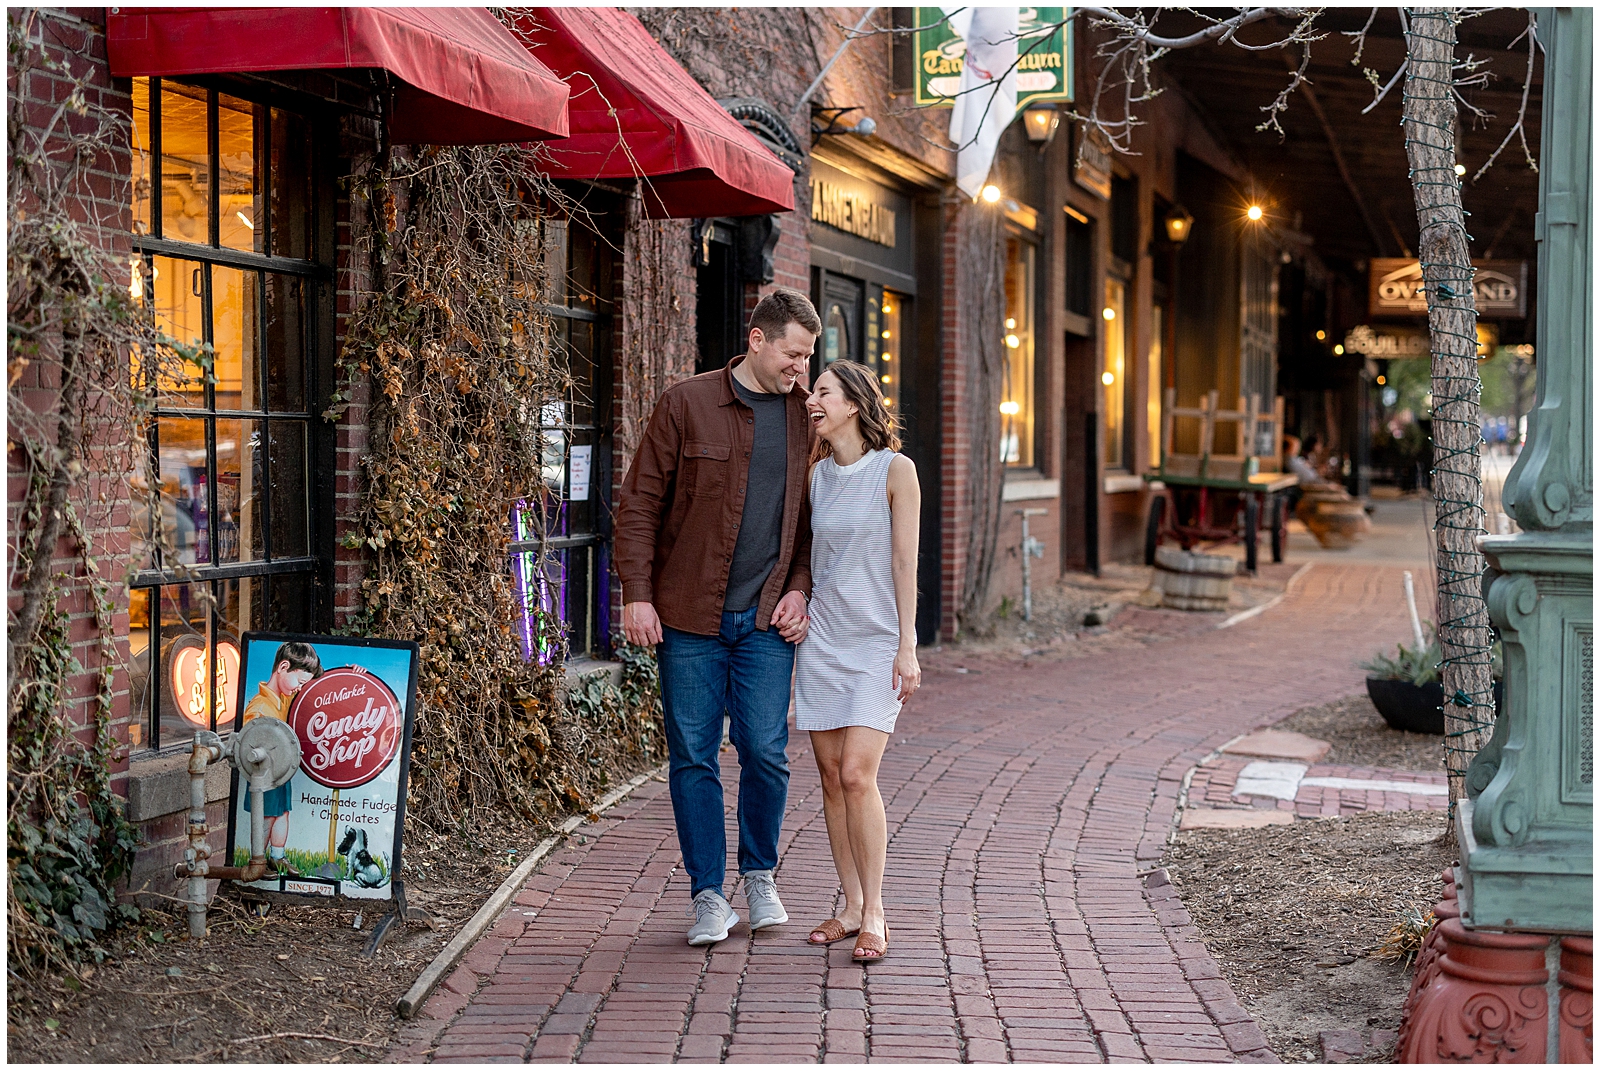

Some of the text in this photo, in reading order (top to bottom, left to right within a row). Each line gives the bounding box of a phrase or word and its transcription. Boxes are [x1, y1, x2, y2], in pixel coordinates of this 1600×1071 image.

[922, 50, 1061, 74] Tanaum
[809, 177, 895, 248] ANNENBAUM
[1344, 335, 1431, 354] BOUILLO
[314, 684, 366, 709] Old Market
[307, 698, 387, 744] Candy
[310, 735, 376, 770] Shop
[301, 792, 397, 814] Handmade Fudge
[319, 809, 379, 824] Chocolates
[288, 883, 332, 894] SINCE 1977
